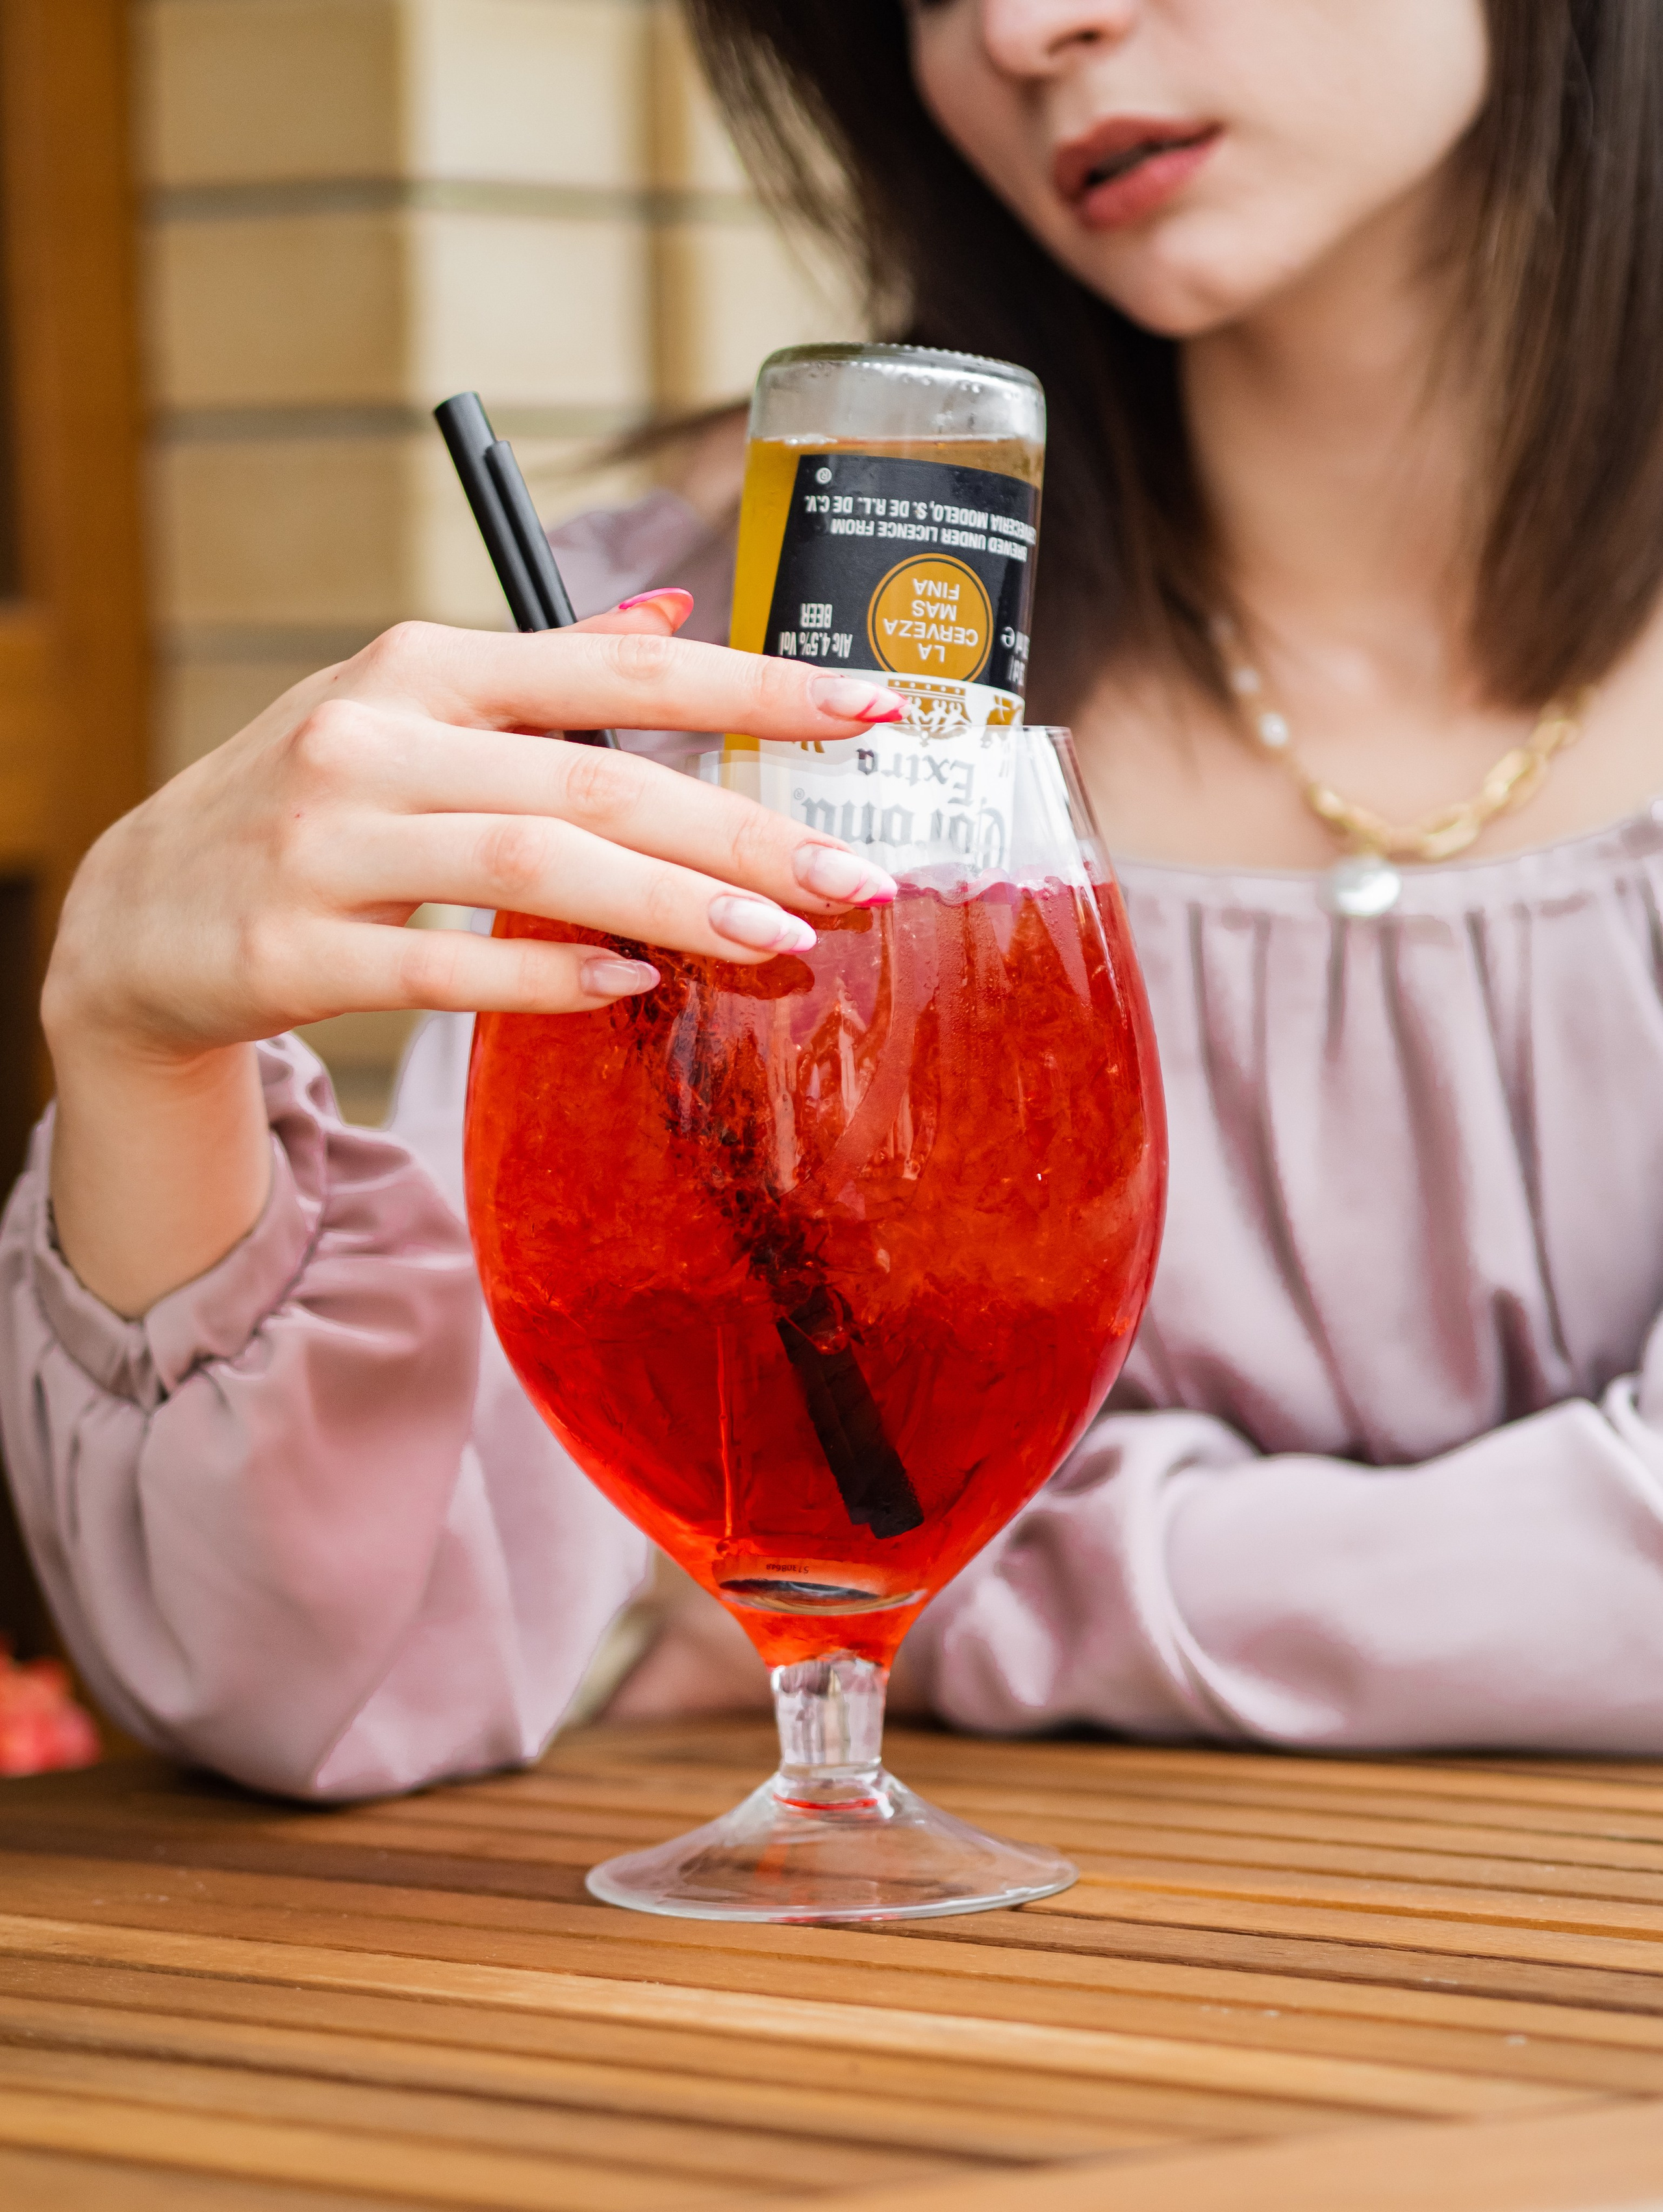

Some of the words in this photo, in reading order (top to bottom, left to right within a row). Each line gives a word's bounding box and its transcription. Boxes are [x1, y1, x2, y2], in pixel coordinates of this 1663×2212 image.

[804, 495, 830, 513] C.V.
[832, 496, 854, 514] DE
[857, 497, 887, 516] R.L.
[889, 499, 909, 518] DE
[912, 501, 928, 520] S.
[929, 501, 989, 529] MODELO,
[830, 518, 875, 536] FROM
[878, 521, 939, 542] LICENCE
[941, 527, 987, 550] UNDER
[987, 536, 1028, 562] BREWED
[913, 578, 960, 600] FINA
[800, 603, 832, 628] BEER
[911, 599, 957, 622] MAS
[779, 631, 796, 656] Vol
[883, 618, 978, 646] CERVEZA
[799, 632, 831, 657] 4.5%
[832, 632, 853, 658] Alc
[918, 643, 945, 662] LA
[857, 748, 975, 807] Extra
[801, 797, 1006, 870] Corona
